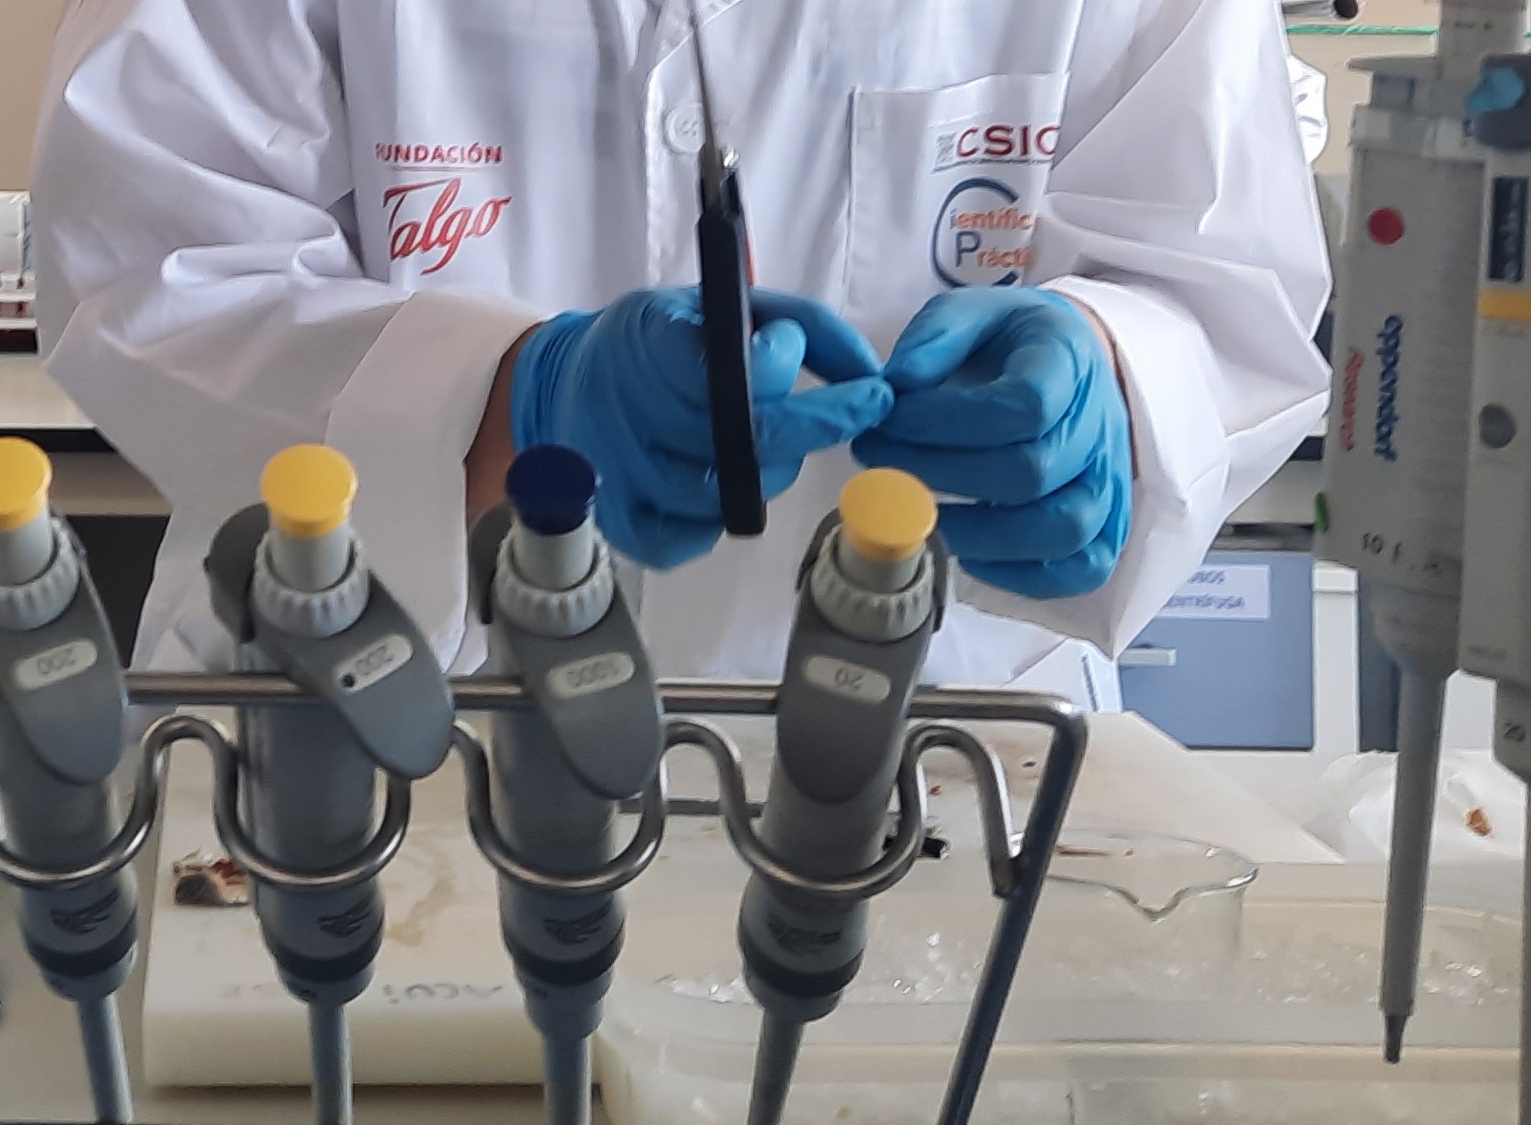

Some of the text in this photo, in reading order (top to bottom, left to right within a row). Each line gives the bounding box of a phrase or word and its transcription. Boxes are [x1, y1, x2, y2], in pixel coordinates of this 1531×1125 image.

[375, 141, 504, 164] FUNDACIÓN
[956, 124, 1061, 158] CSIC
[382, 177, 512, 276] Talgo
